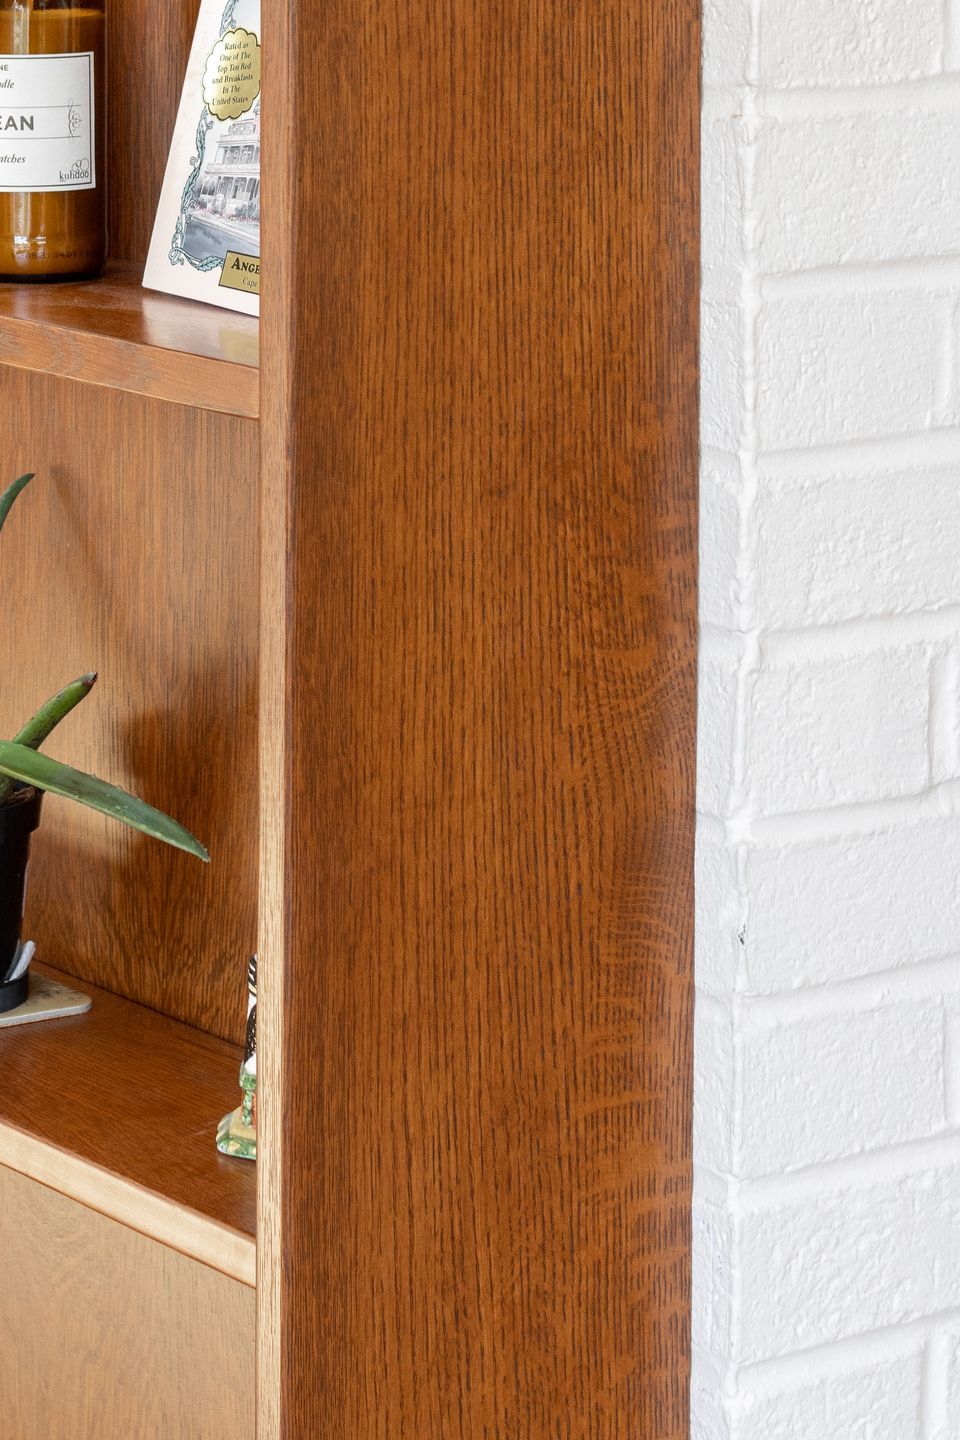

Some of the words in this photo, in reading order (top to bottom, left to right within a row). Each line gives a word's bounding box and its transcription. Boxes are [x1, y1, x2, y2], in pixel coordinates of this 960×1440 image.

[224, 42, 242, 50] Rated
[220, 54, 231, 62] One
[241, 52, 251, 60] The
[218, 64, 228, 74] Top
[230, 64, 240, 72] Ten
[241, 62, 252, 71] Bed
[224, 74, 253, 83] Breakfasts
[230, 85, 241, 93] The
[212, 97, 231, 106] United
[231, 96, 248, 105] States
[59, 170, 89, 180] kuhdoo
[242, 277, 257, 288] Cape
